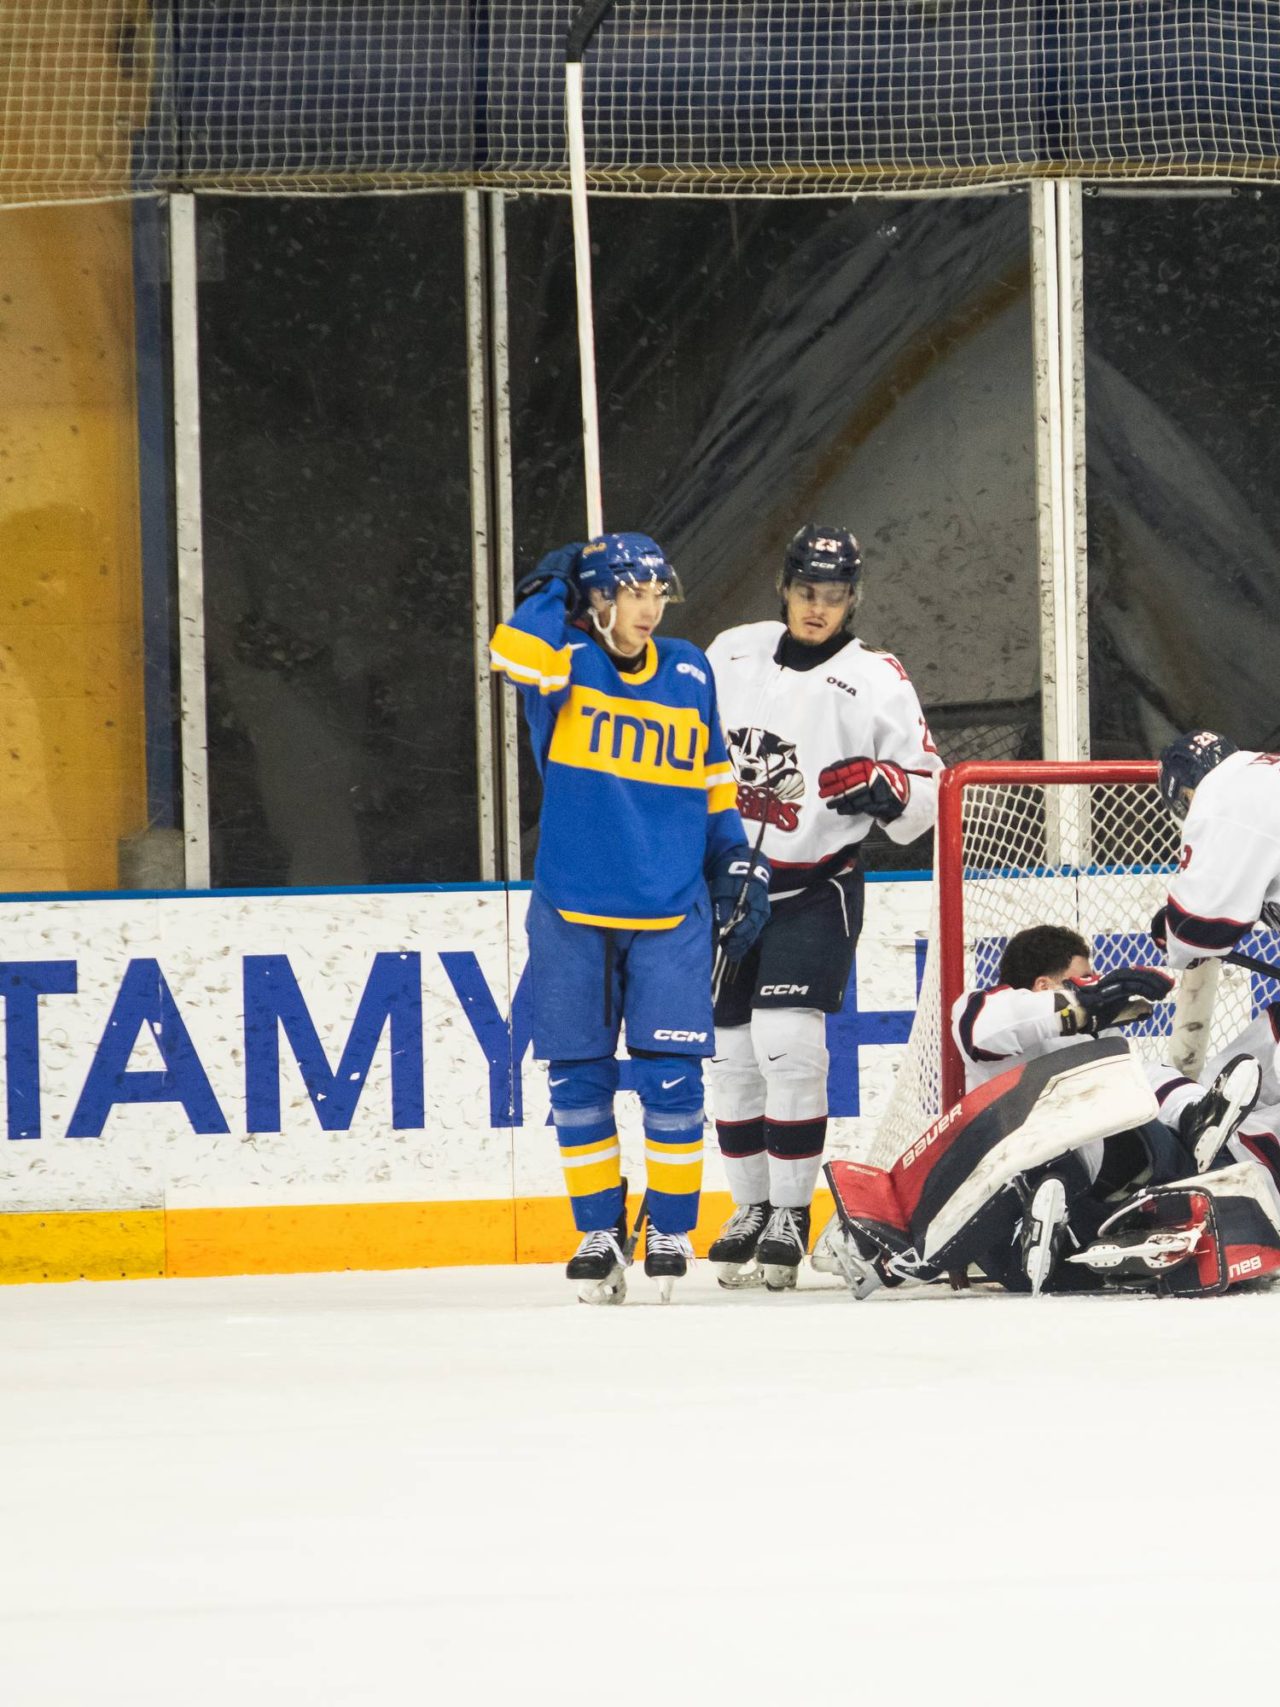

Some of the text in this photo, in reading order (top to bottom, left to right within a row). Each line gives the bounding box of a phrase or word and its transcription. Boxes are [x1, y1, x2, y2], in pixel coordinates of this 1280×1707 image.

[826, 676, 857, 697] OUA
[581, 705, 698, 771] TMU
[760, 984, 809, 996] CCM
[653, 1029, 708, 1043] CCM
